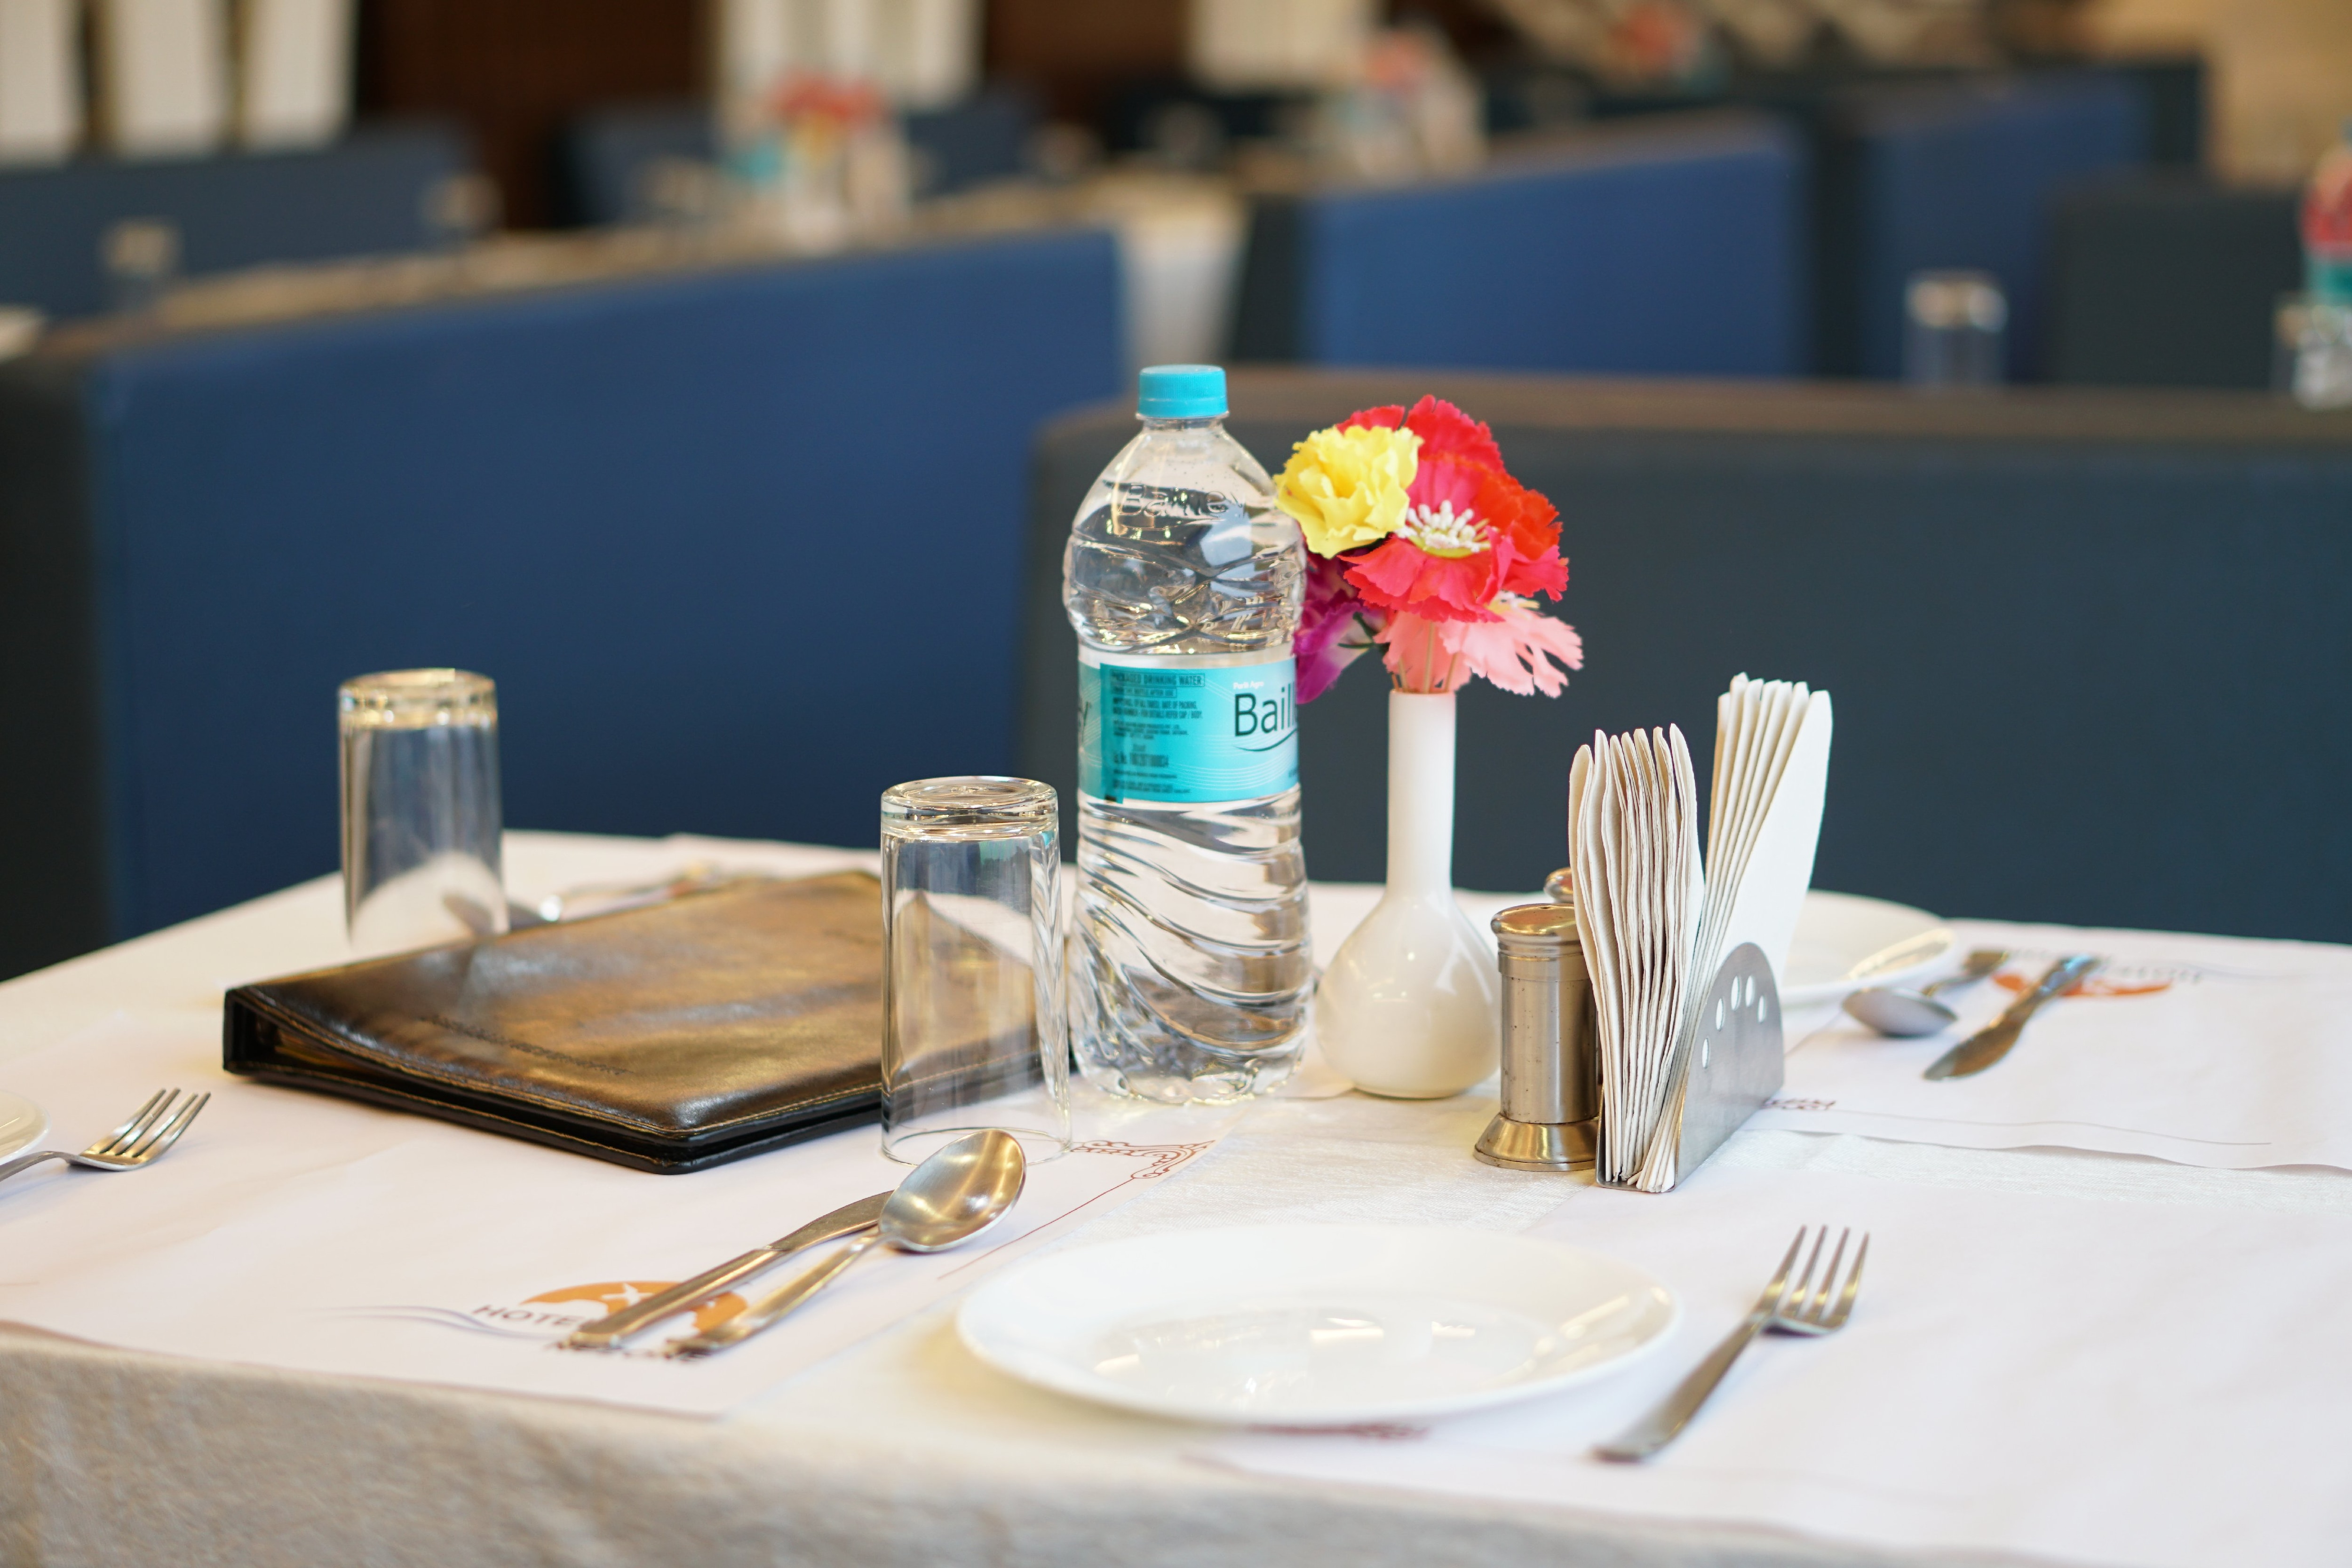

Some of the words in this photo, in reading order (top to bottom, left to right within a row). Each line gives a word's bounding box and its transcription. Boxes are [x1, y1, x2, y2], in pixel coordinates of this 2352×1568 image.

[1144, 674, 1176, 685] DRINKING
[1179, 675, 1202, 685] WATER
[470, 1304, 586, 1326] HOTE
